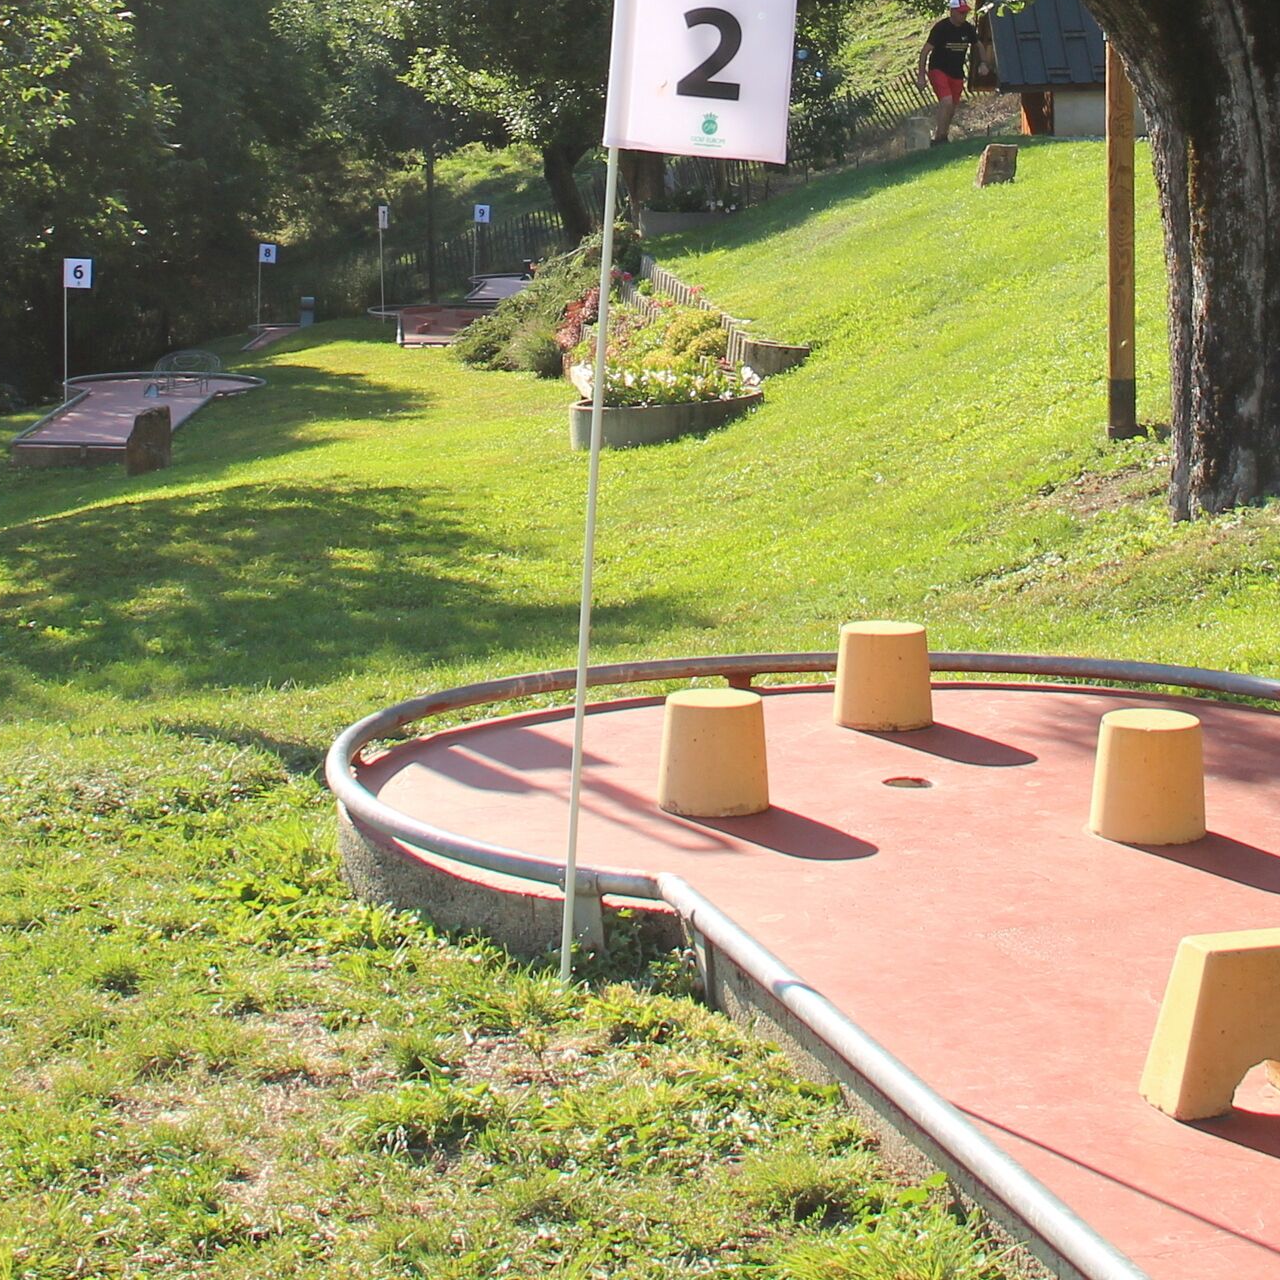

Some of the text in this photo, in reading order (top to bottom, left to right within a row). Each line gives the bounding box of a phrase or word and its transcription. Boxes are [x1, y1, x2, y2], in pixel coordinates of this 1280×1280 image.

[676, 6, 742, 101] 2
[479, 208, 485, 217] 9
[264, 248, 271, 258] 8
[73, 264, 84, 280] 6
